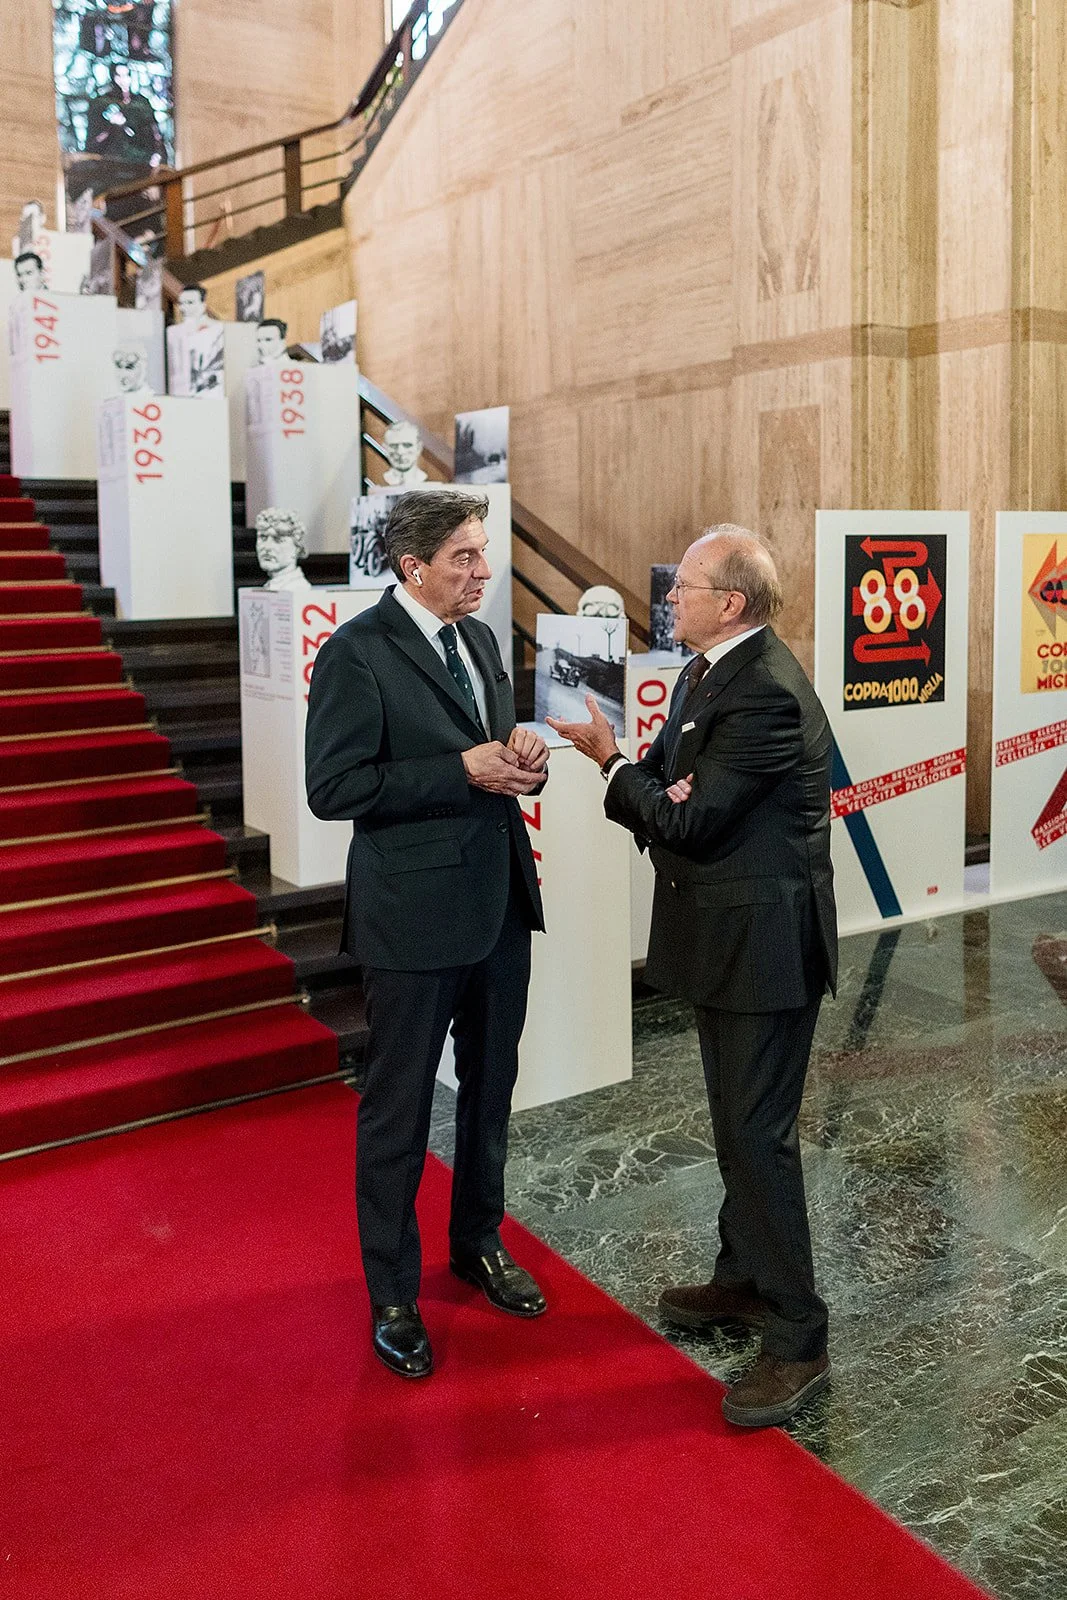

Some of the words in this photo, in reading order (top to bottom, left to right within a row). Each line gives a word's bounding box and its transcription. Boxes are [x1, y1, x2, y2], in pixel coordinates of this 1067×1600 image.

[33, 297, 61, 364] 1947
[280, 369, 305, 438] 1938
[132, 403, 164, 484] 1936
[859, 568, 926, 634] 88
[844, 681, 888, 701] COPPA
[886, 676, 919, 704] 1000
[917, 671, 944, 704] MIGLIA
[830, 786, 853, 802] CCIA
[856, 775, 883, 793] ROSSA
[891, 761, 926, 781] BRESCIA
[933, 751, 956, 767] ROMA
[905, 767, 951, 791] PASSIONE
